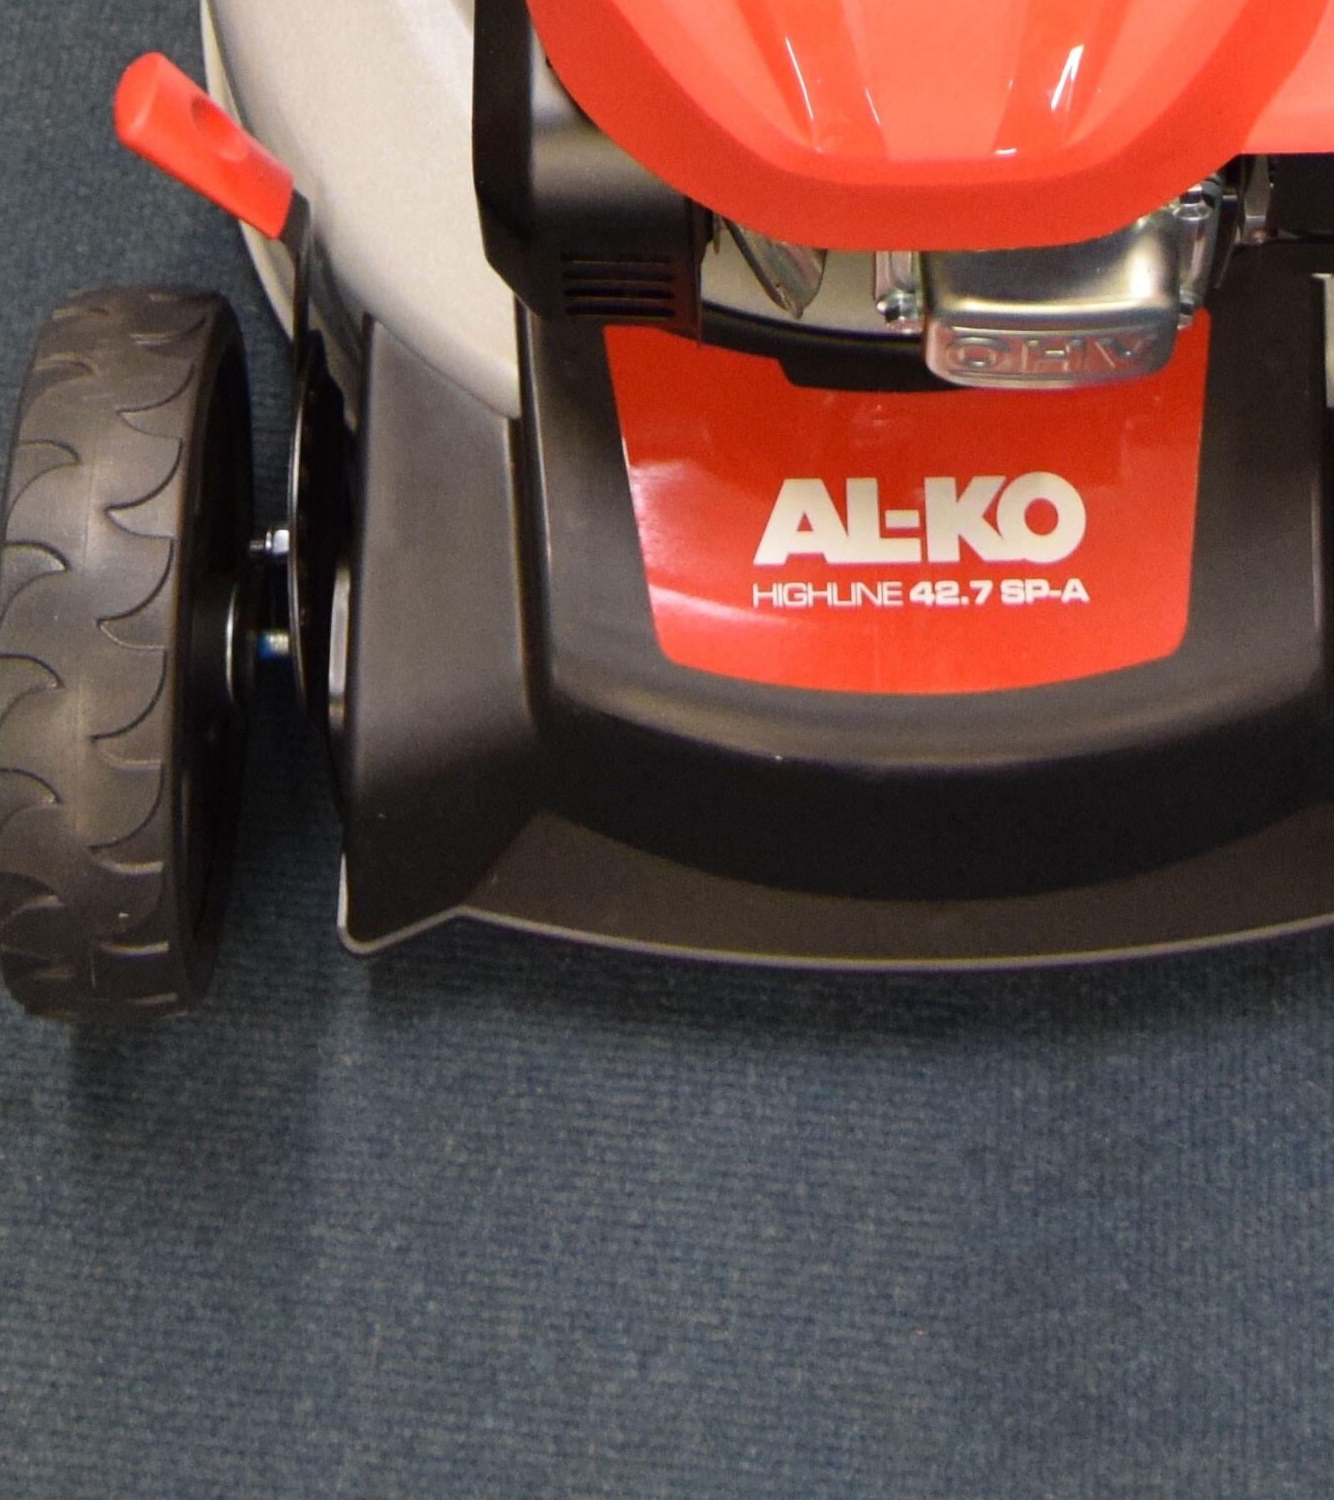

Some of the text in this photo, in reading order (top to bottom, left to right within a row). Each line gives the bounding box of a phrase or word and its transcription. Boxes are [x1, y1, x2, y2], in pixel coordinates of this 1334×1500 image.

[946, 334, 1155, 376] OHV
[753, 471, 1087, 565] AL-KO
[753, 578, 1090, 608] HIGHLINE 42.7 SP-A
